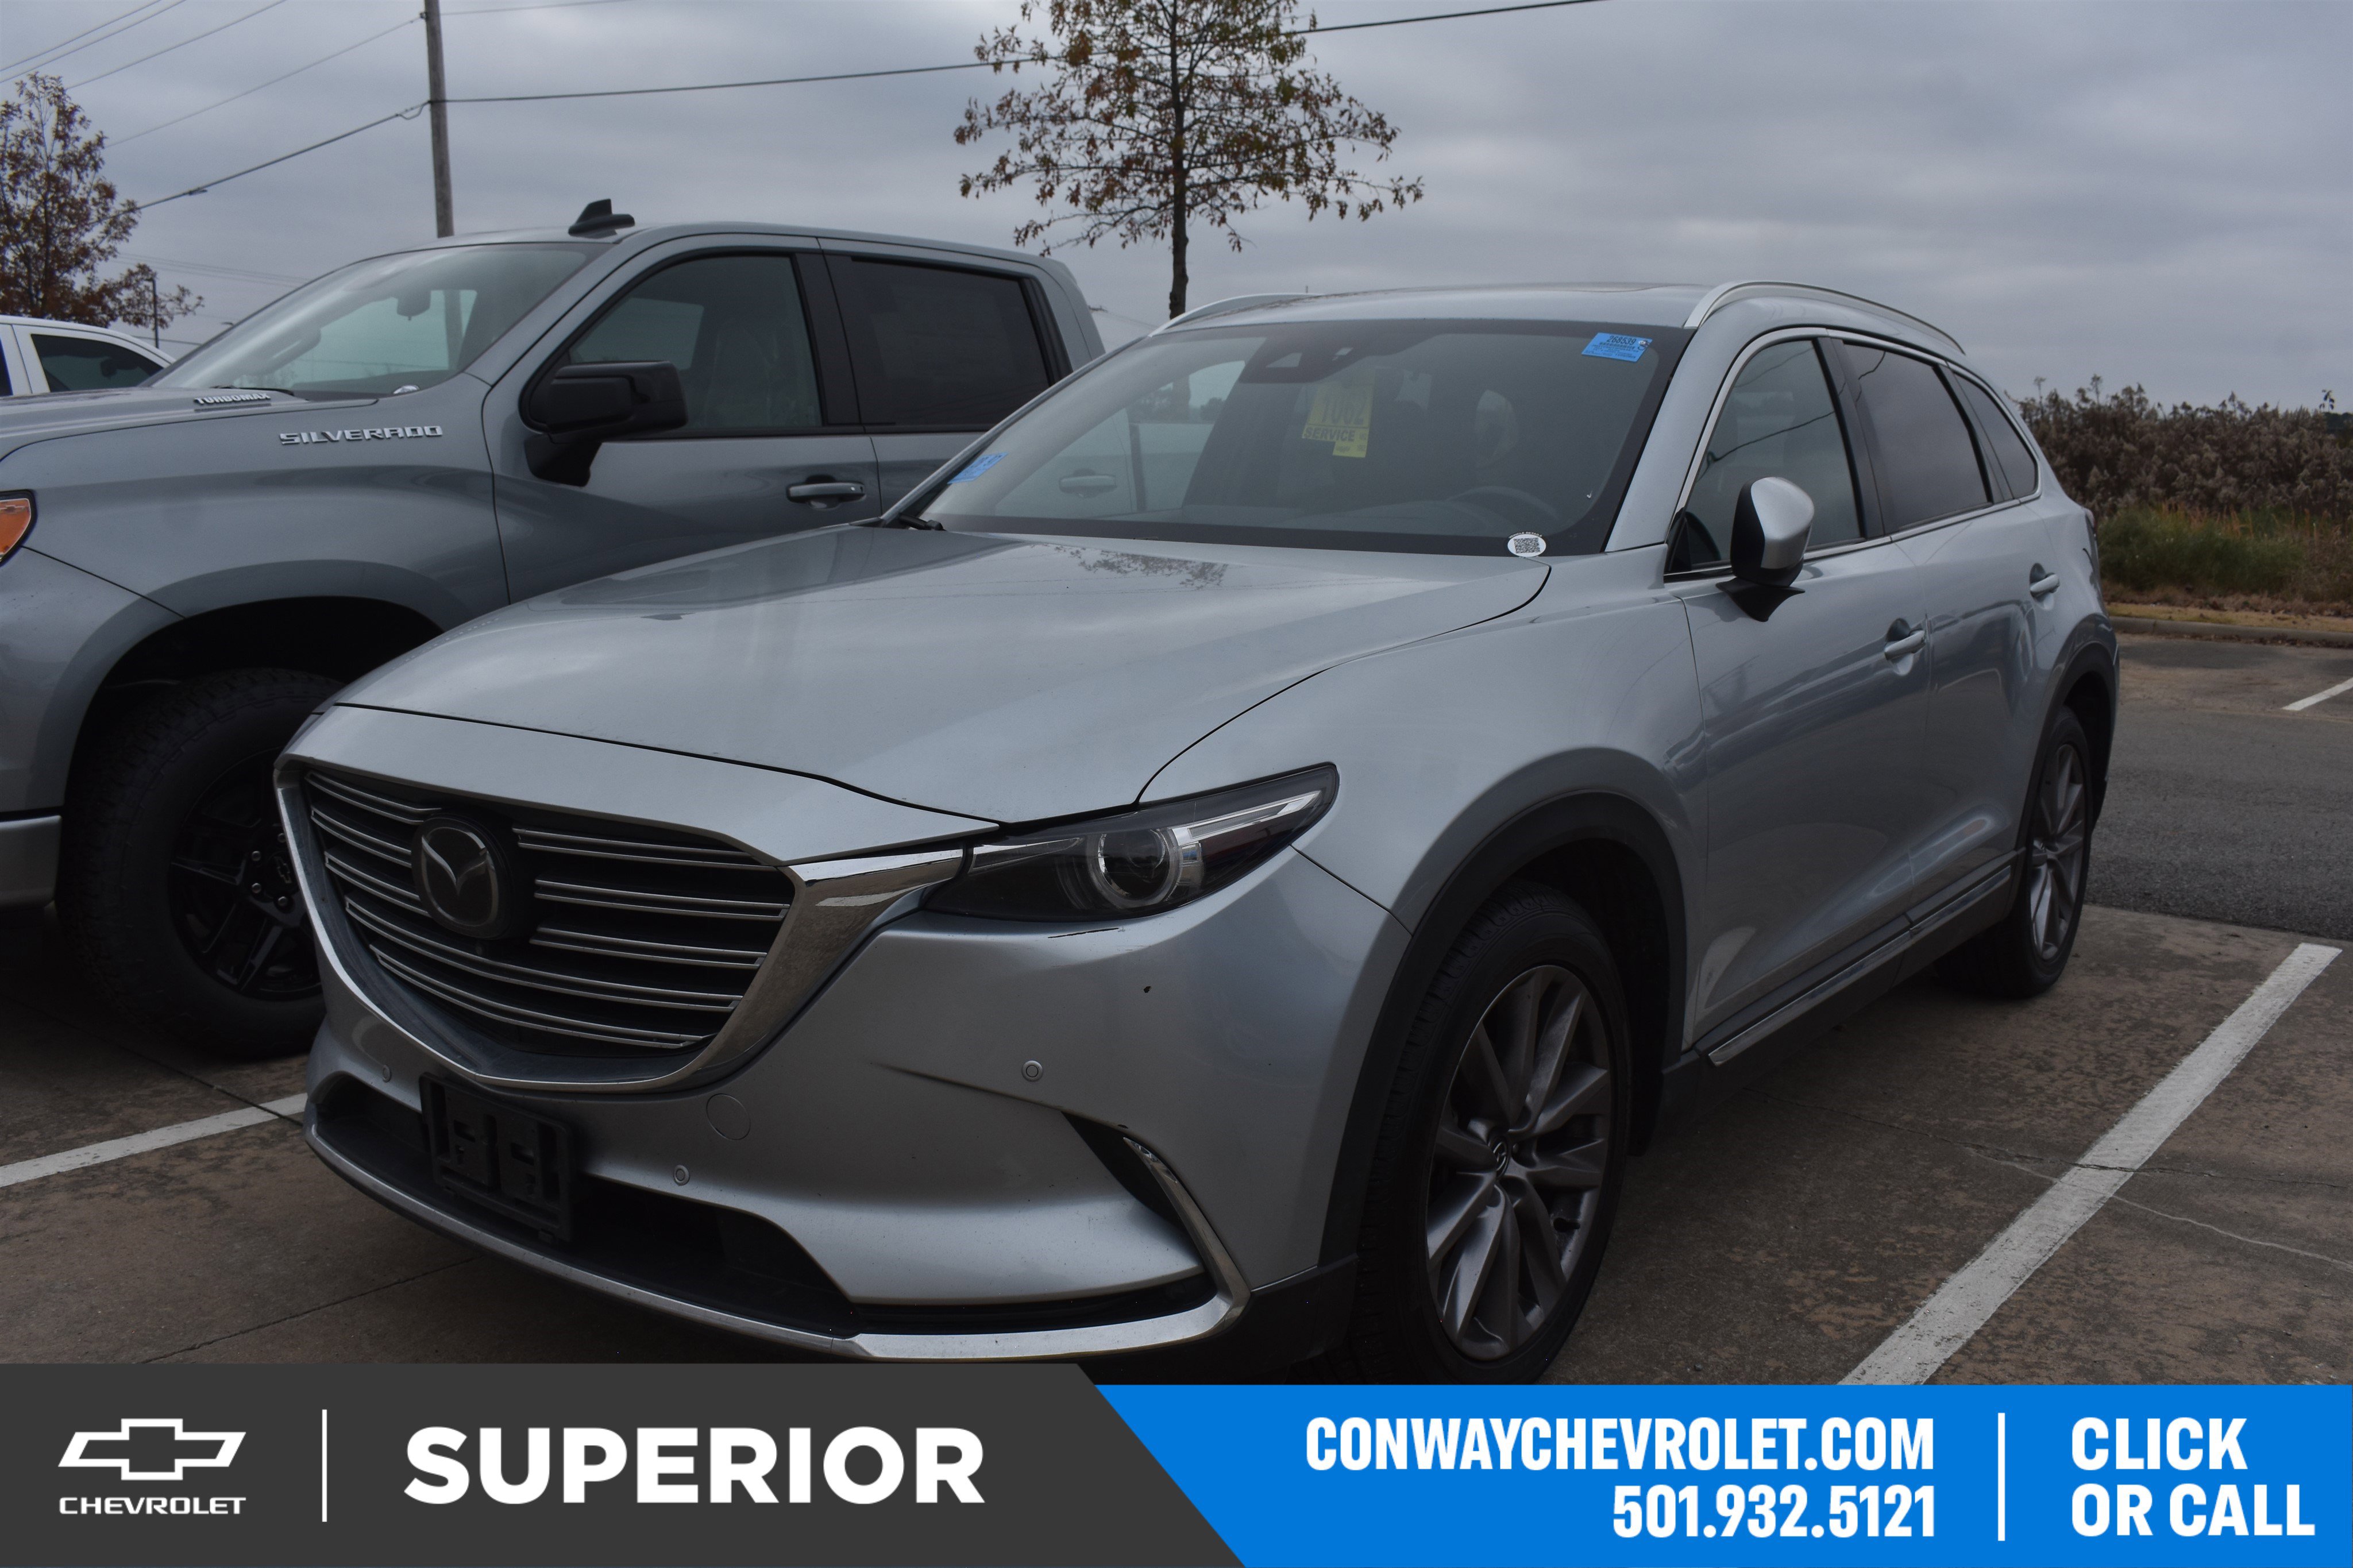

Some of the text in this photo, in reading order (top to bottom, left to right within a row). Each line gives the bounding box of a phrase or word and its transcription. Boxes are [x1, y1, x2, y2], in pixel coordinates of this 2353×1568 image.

[1606, 335, 1637, 345] 268539
[194, 392, 271, 405] TURBOMAX
[279, 425, 443, 445] SILVERADO
[1305, 426, 1356, 442] SERVICE
